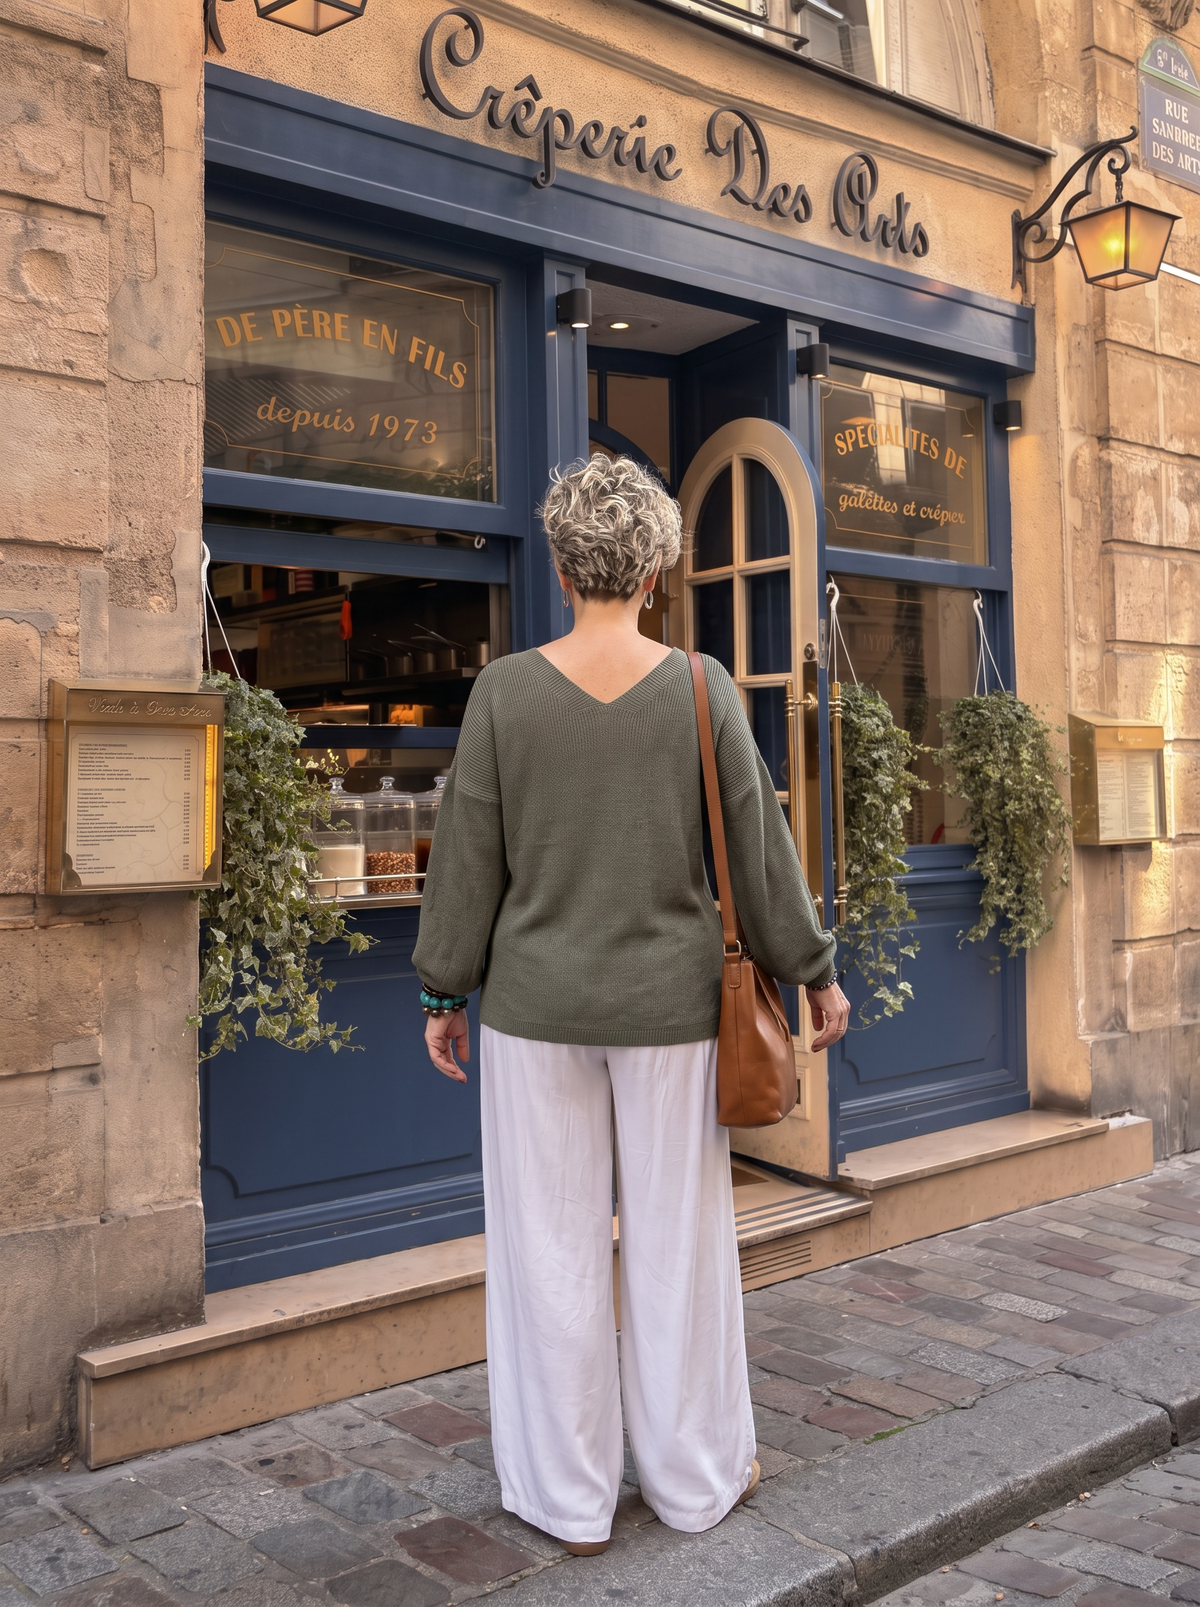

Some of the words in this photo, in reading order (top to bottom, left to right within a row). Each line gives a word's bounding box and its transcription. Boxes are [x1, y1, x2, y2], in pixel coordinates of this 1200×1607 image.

[1164, 98, 1189, 124] RUE
[419, 7, 683, 190] Crêperie
[704, 105, 813, 224] Des
[831, 151, 930, 258] Arts
[1152, 141, 1174, 165] DES
[215, 311, 263, 348] DE
[271, 303, 351, 342] PÈRE
[362, 318, 398, 356] EN
[407, 335, 468, 389] FILS
[255, 396, 356, 433] depuis
[368, 413, 439, 445] 1973
[943, 446, 968, 480] DE
[902, 500, 917, 517] et
